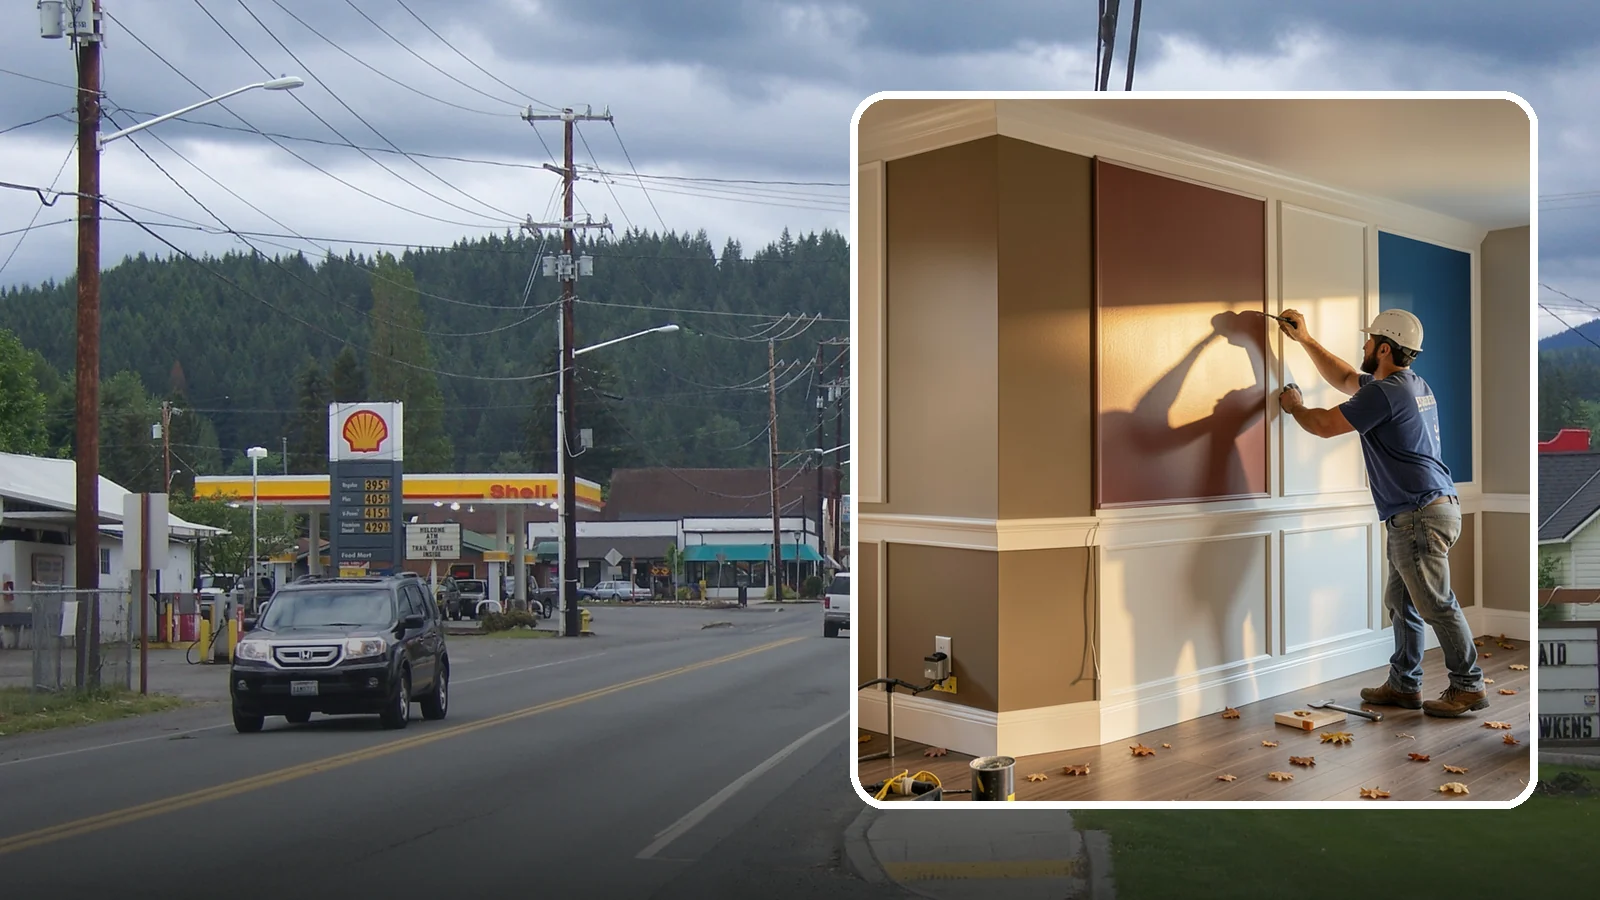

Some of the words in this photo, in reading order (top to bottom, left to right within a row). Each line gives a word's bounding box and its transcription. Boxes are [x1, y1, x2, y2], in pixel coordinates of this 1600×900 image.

[366, 479, 384, 490] 395
[490, 484, 547, 498] Shell
[366, 494, 384, 504] 405
[366, 508, 384, 518] 415
[366, 522, 384, 533] 429
[1538, 642, 1567, 666] AID
